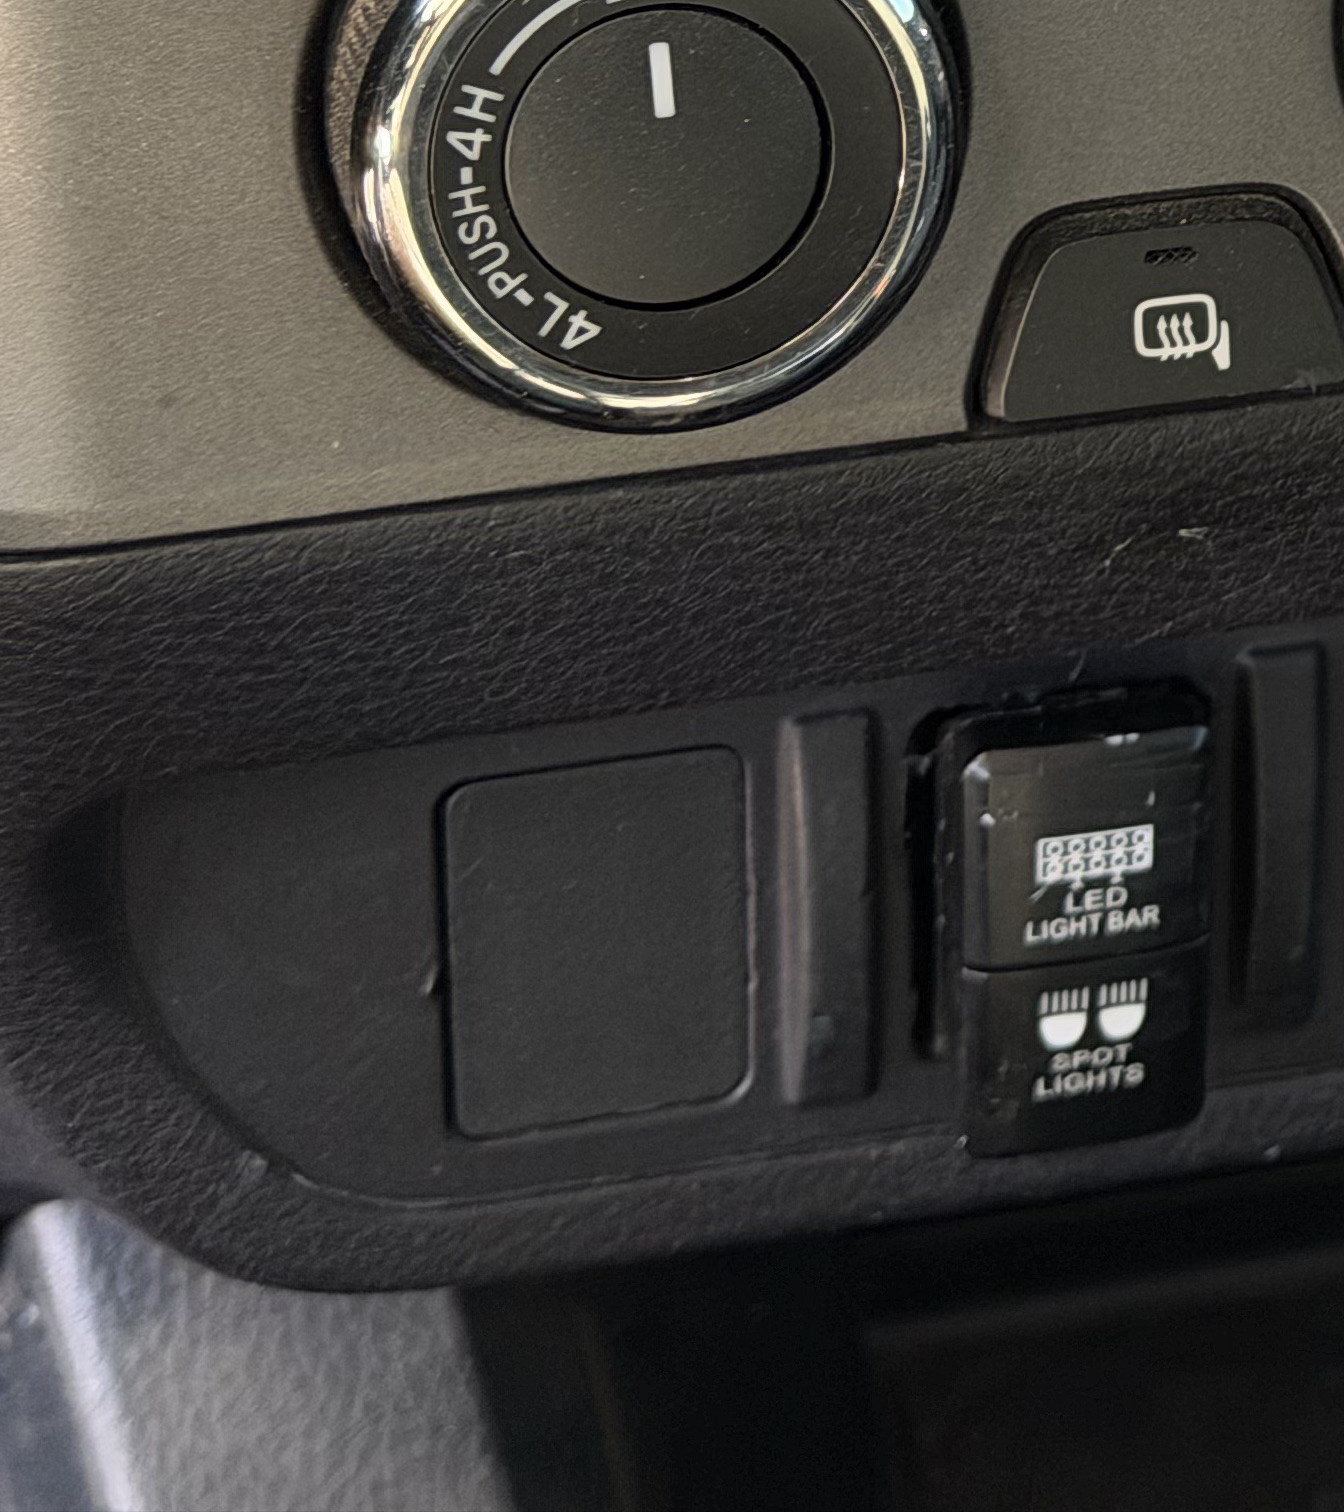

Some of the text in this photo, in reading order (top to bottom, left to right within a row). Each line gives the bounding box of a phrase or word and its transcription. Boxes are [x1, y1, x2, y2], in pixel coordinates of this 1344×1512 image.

[1064, 886, 1129, 915] LED
[1023, 903, 1161, 945] LIGHT BAR
[1051, 1042, 1133, 1072] SPOT
[1032, 1062, 1147, 1101] LIGHTS
